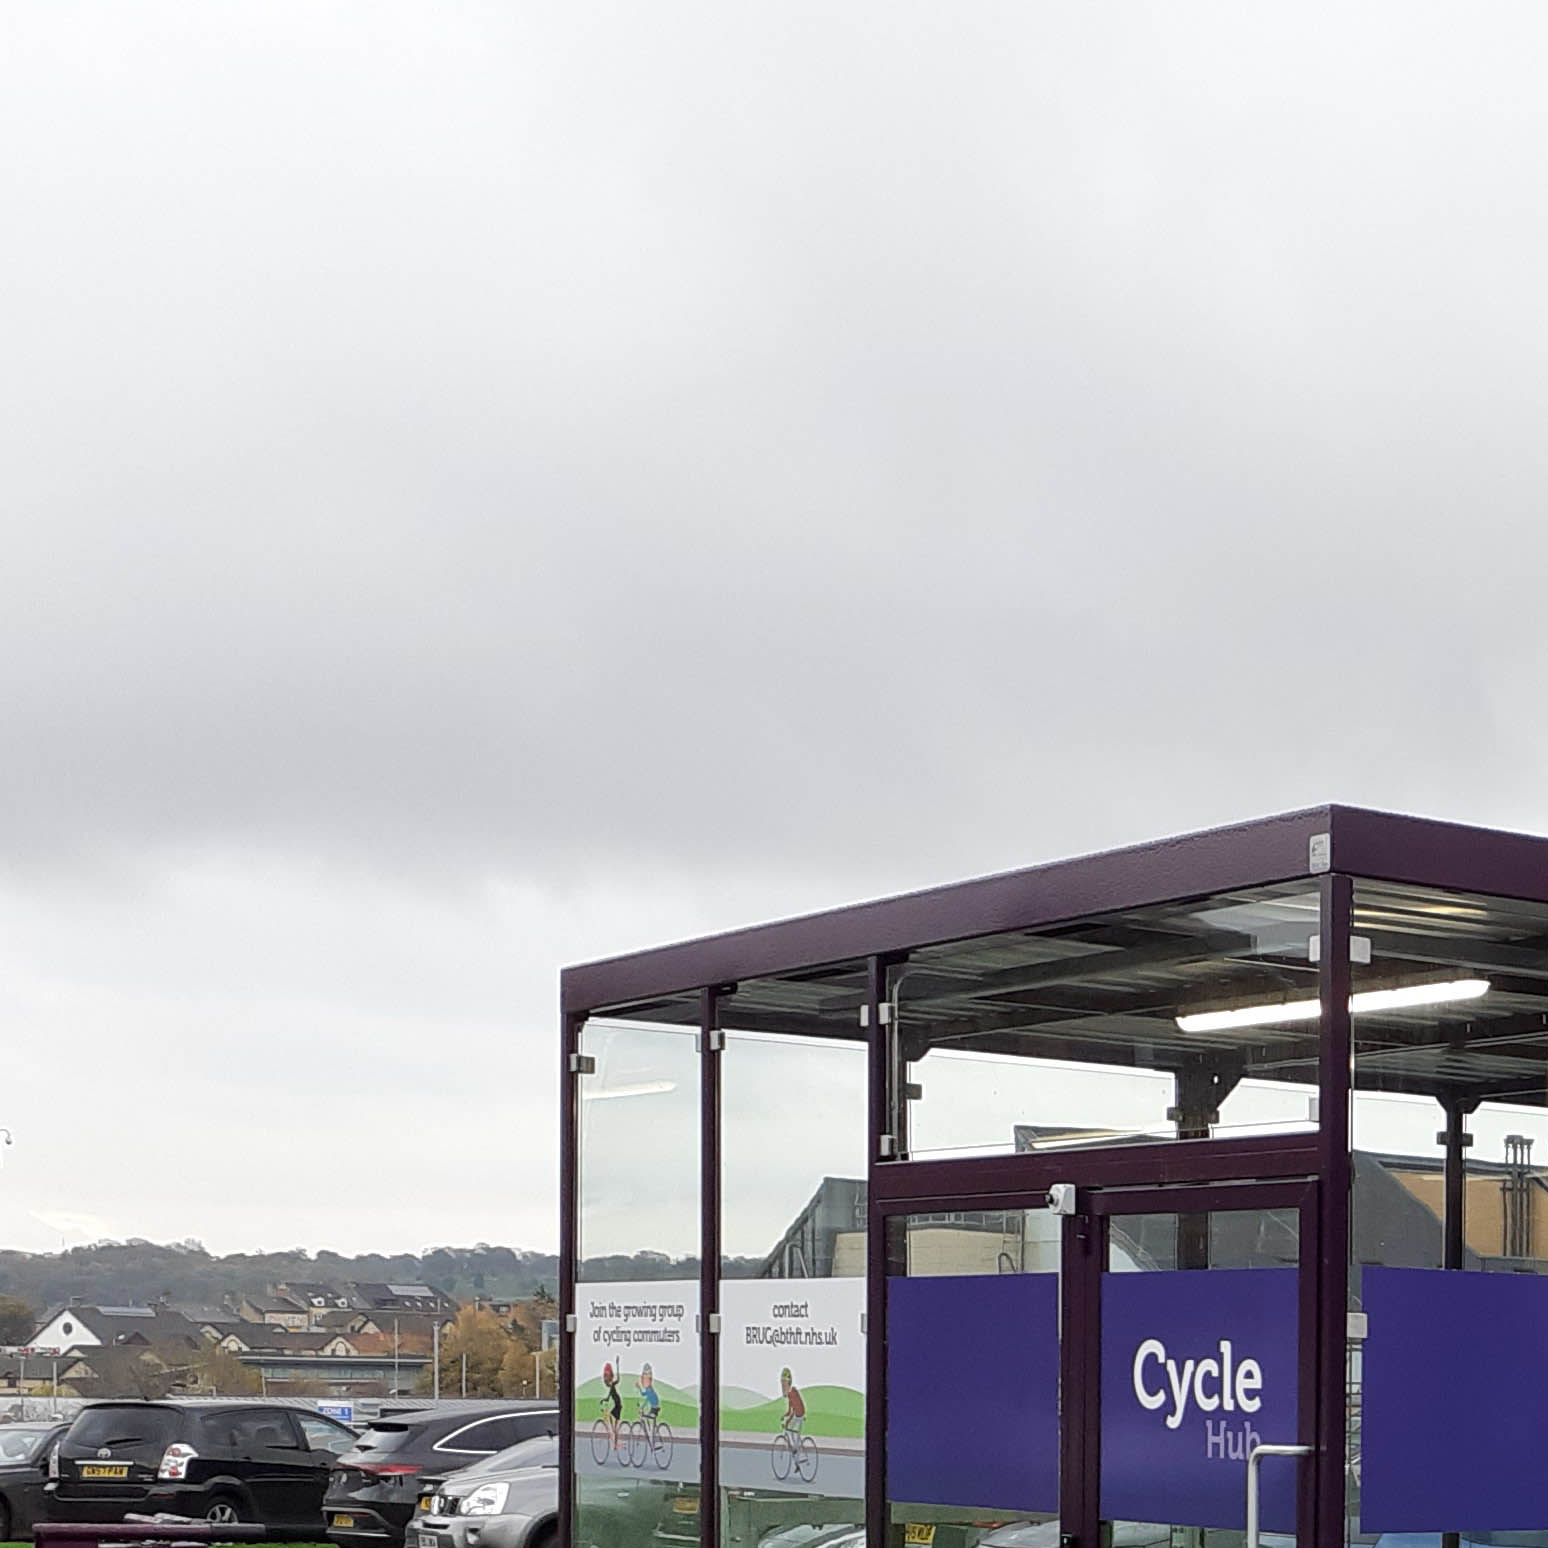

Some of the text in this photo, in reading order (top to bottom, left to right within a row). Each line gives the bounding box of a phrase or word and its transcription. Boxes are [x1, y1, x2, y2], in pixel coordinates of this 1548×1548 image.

[590, 1301, 684, 1322] Join the growing group
[772, 1301, 809, 1318] contact
[593, 1326, 680, 1346] of cycling commuters
[1133, 1338, 1263, 1429] Cycle
